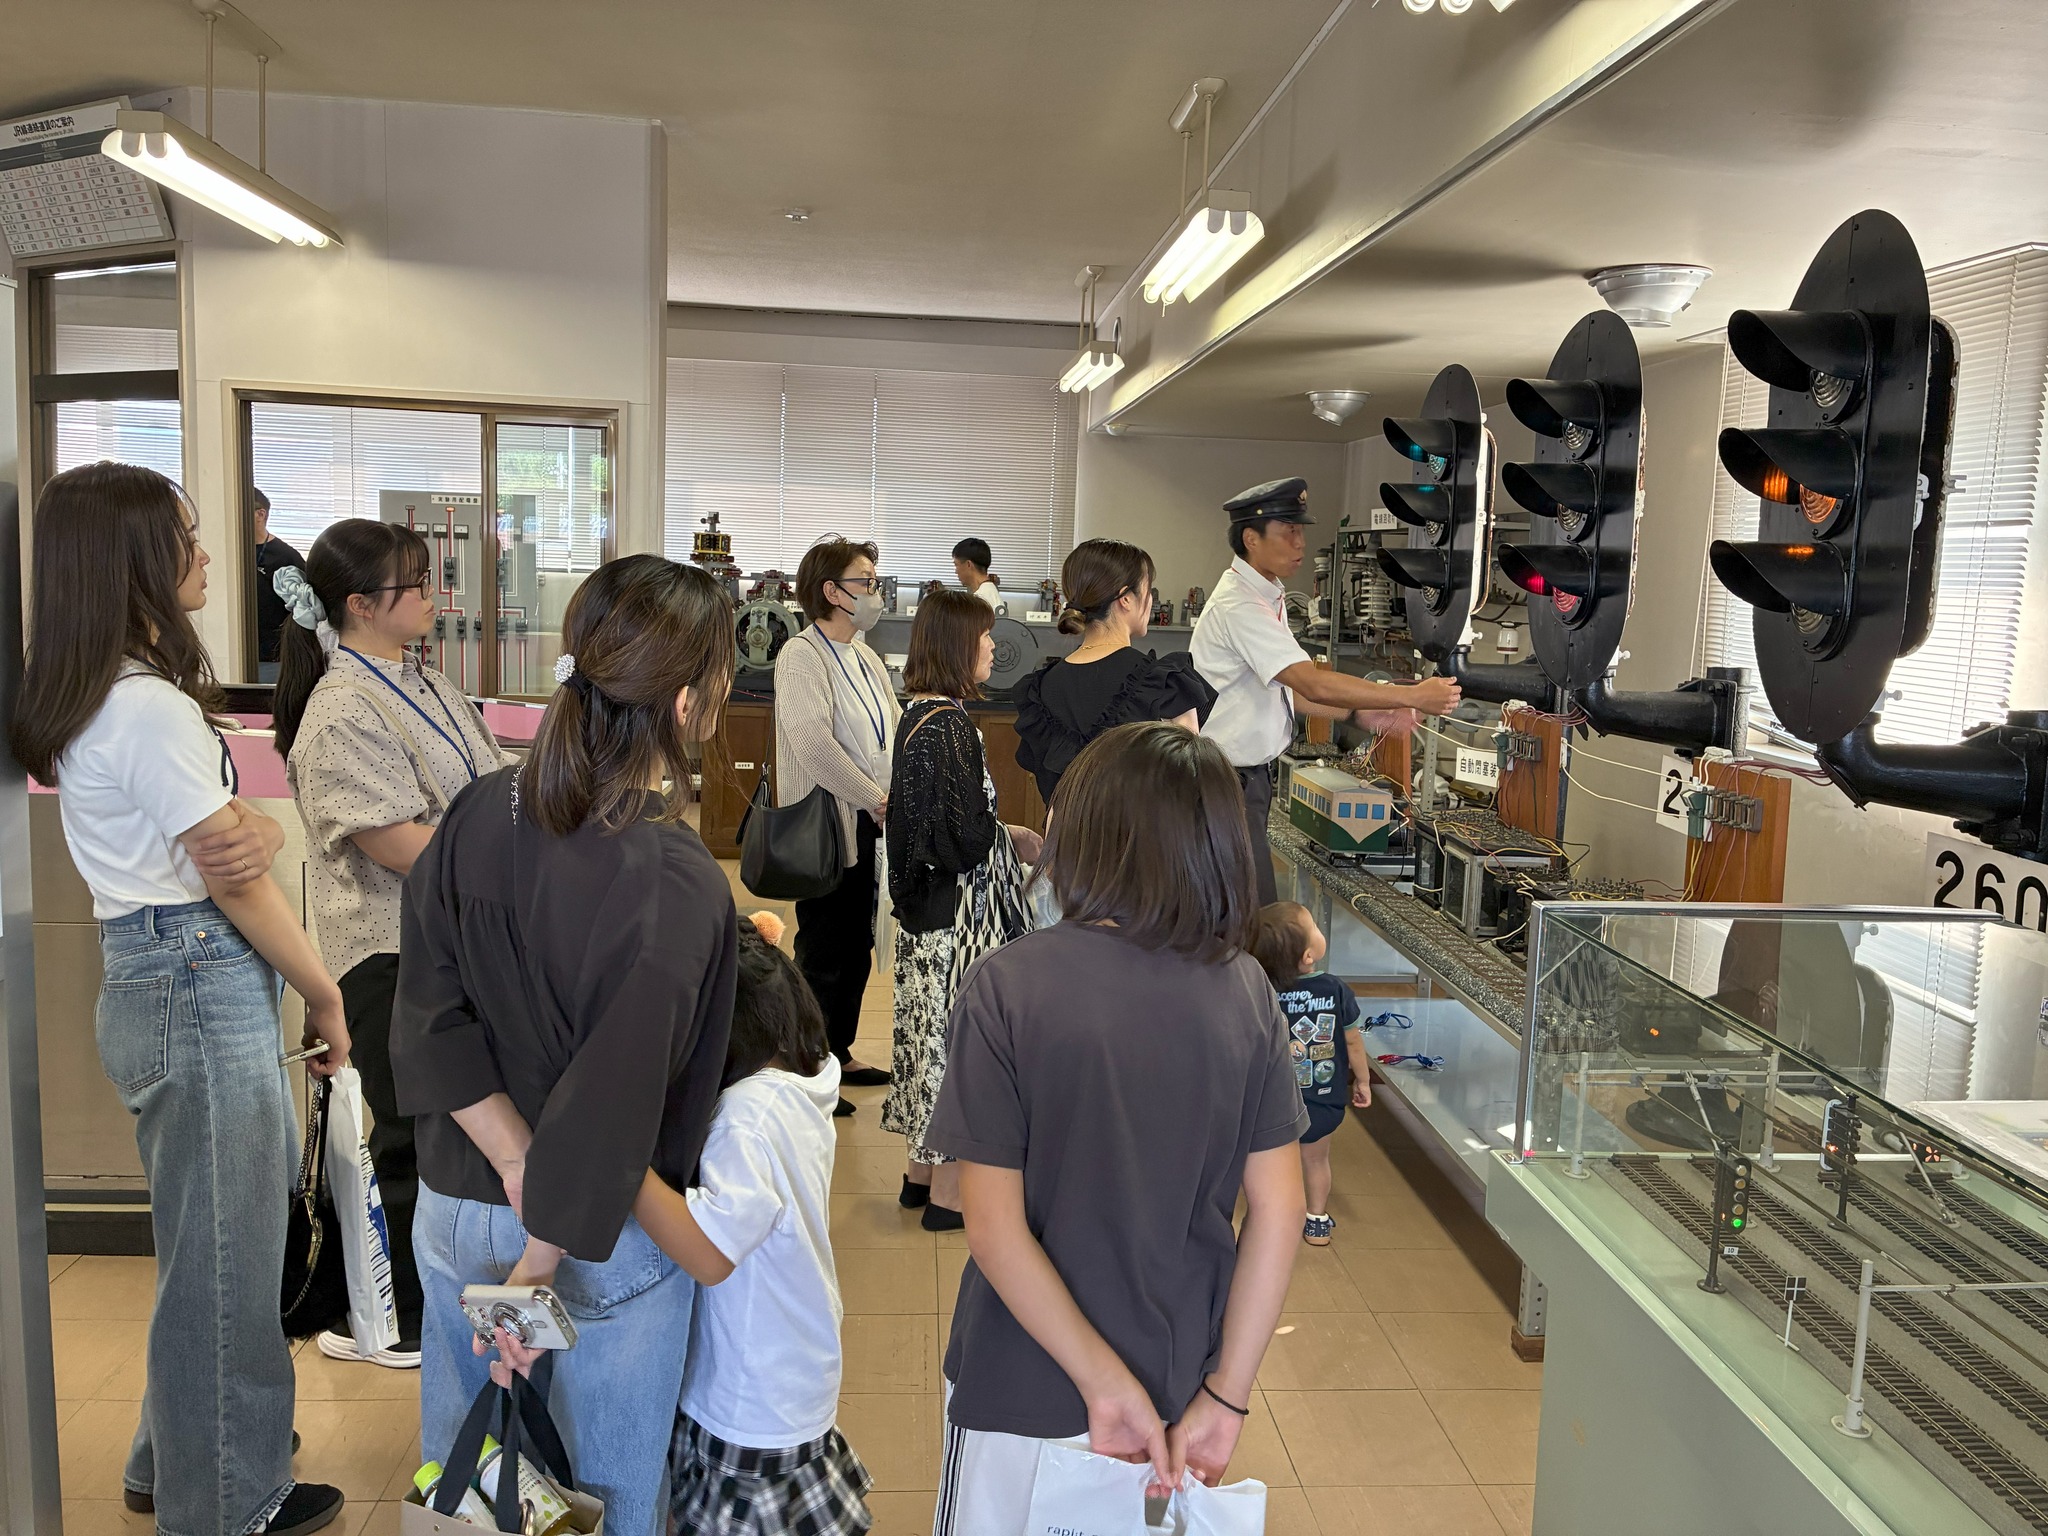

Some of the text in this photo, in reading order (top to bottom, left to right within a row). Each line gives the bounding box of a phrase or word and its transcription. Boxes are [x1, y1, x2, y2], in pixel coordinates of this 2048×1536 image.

[1460, 756, 1497, 779] 自動閉塞装
[1662, 768, 1684, 819] 2
[1277, 990, 1314, 1002] scover
[1287, 995, 1336, 1014] the Wild
